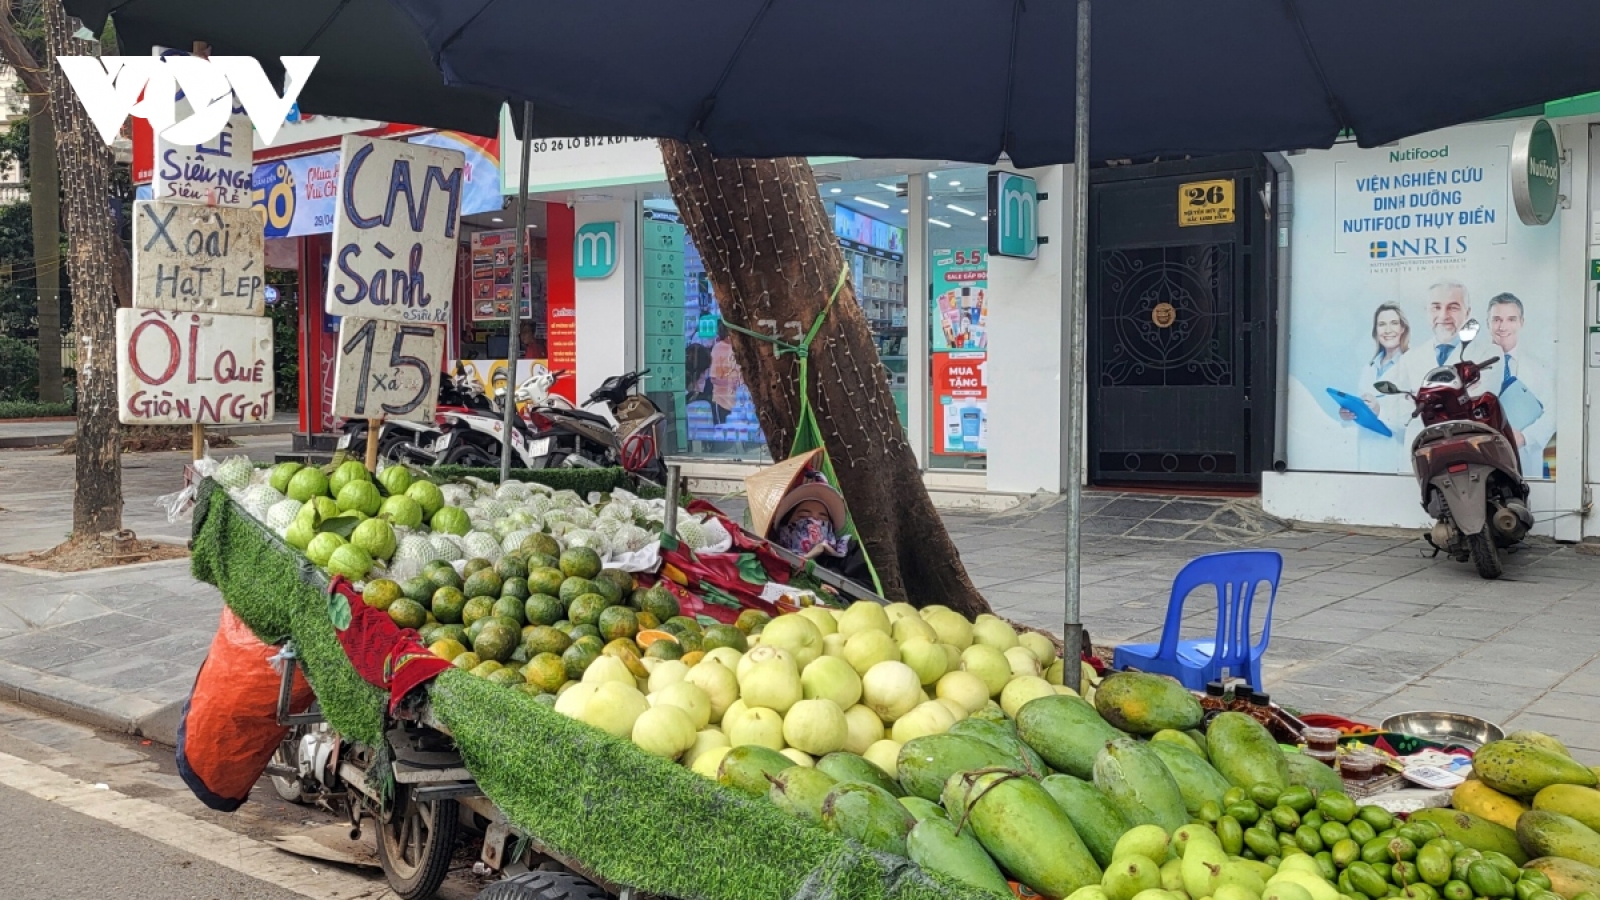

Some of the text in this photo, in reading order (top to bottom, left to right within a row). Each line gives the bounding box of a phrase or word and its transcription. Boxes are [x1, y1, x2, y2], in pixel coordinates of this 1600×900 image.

[551, 142, 563, 152] 26
[160, 149, 217, 183] Siêu
[164, 182, 203, 199] Siêu
[343, 142, 464, 239] CAM
[1356, 165, 1484, 194] VIỆN NGHIÊN CỨU
[1188, 185, 1225, 206] 26
[1409, 189, 1462, 207] DƯỠNG
[1415, 212, 1455, 229] THỤY
[1458, 204, 1496, 226] ĐIỂN
[142, 203, 230, 258] Xoài
[955, 250, 981, 265] 5.5
[334, 241, 432, 309] Sành
[343, 319, 436, 416] 15
[949, 366, 974, 376] MUA
[949, 376, 978, 388] TẶNG
